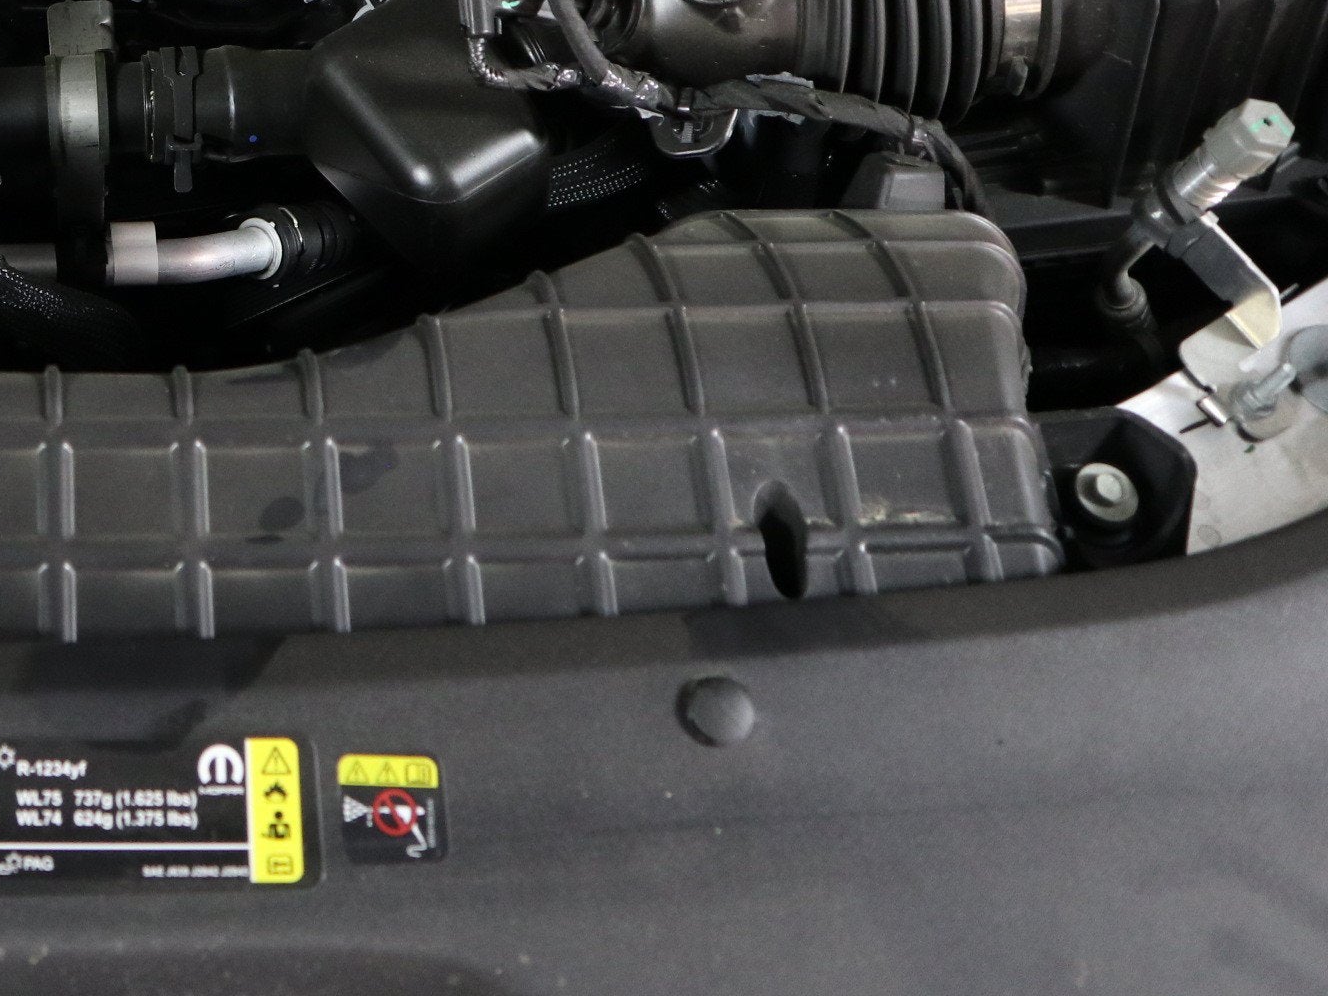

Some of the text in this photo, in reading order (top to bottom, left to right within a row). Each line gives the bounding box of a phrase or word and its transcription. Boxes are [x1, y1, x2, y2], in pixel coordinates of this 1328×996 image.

[15, 759, 88, 781] R-1234yf
[15, 788, 198, 811] WL75 737g (1.625 lbs)
[15, 808, 199, 831] WL74 624g (1.375 lbs)
[22, 854, 55, 872] PAG
